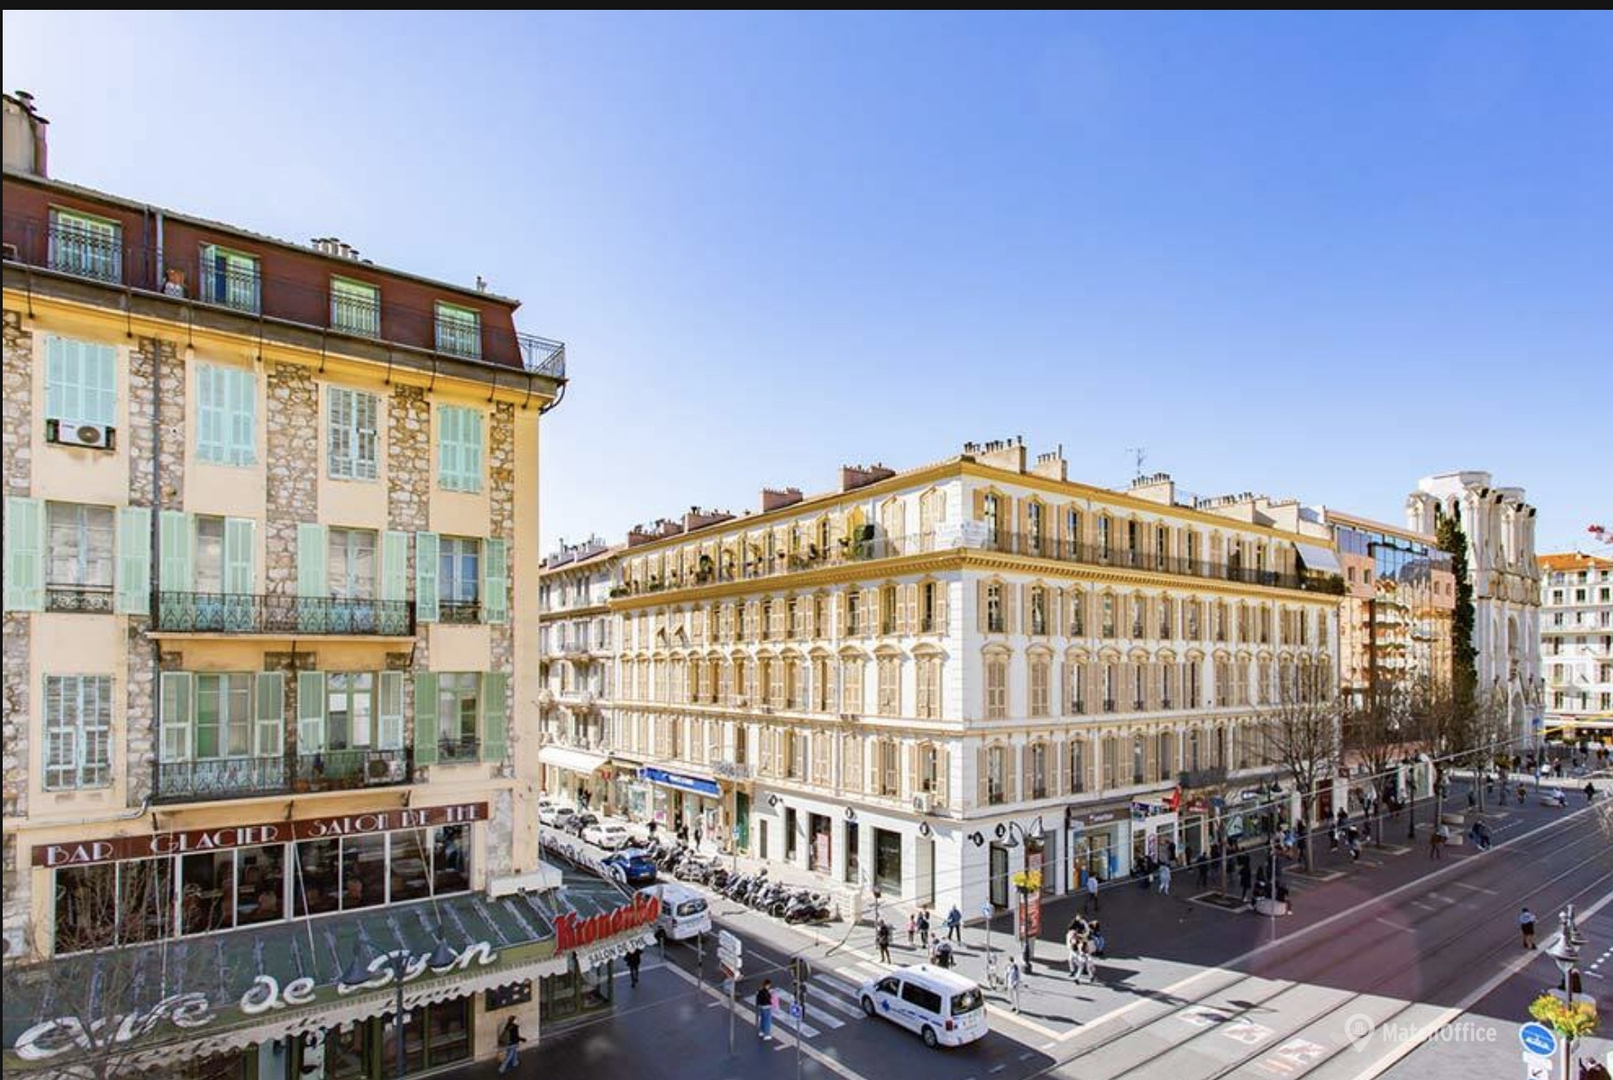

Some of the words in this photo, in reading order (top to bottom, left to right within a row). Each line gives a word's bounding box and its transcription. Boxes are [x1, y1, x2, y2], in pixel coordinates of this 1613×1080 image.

[46, 841, 114, 866] BAR
[151, 826, 279, 855] GLACIER
[309, 814, 389, 837] SALON
[402, 809, 428, 828] DE
[446, 804, 476, 821] THE
[240, 975, 316, 1014] de
